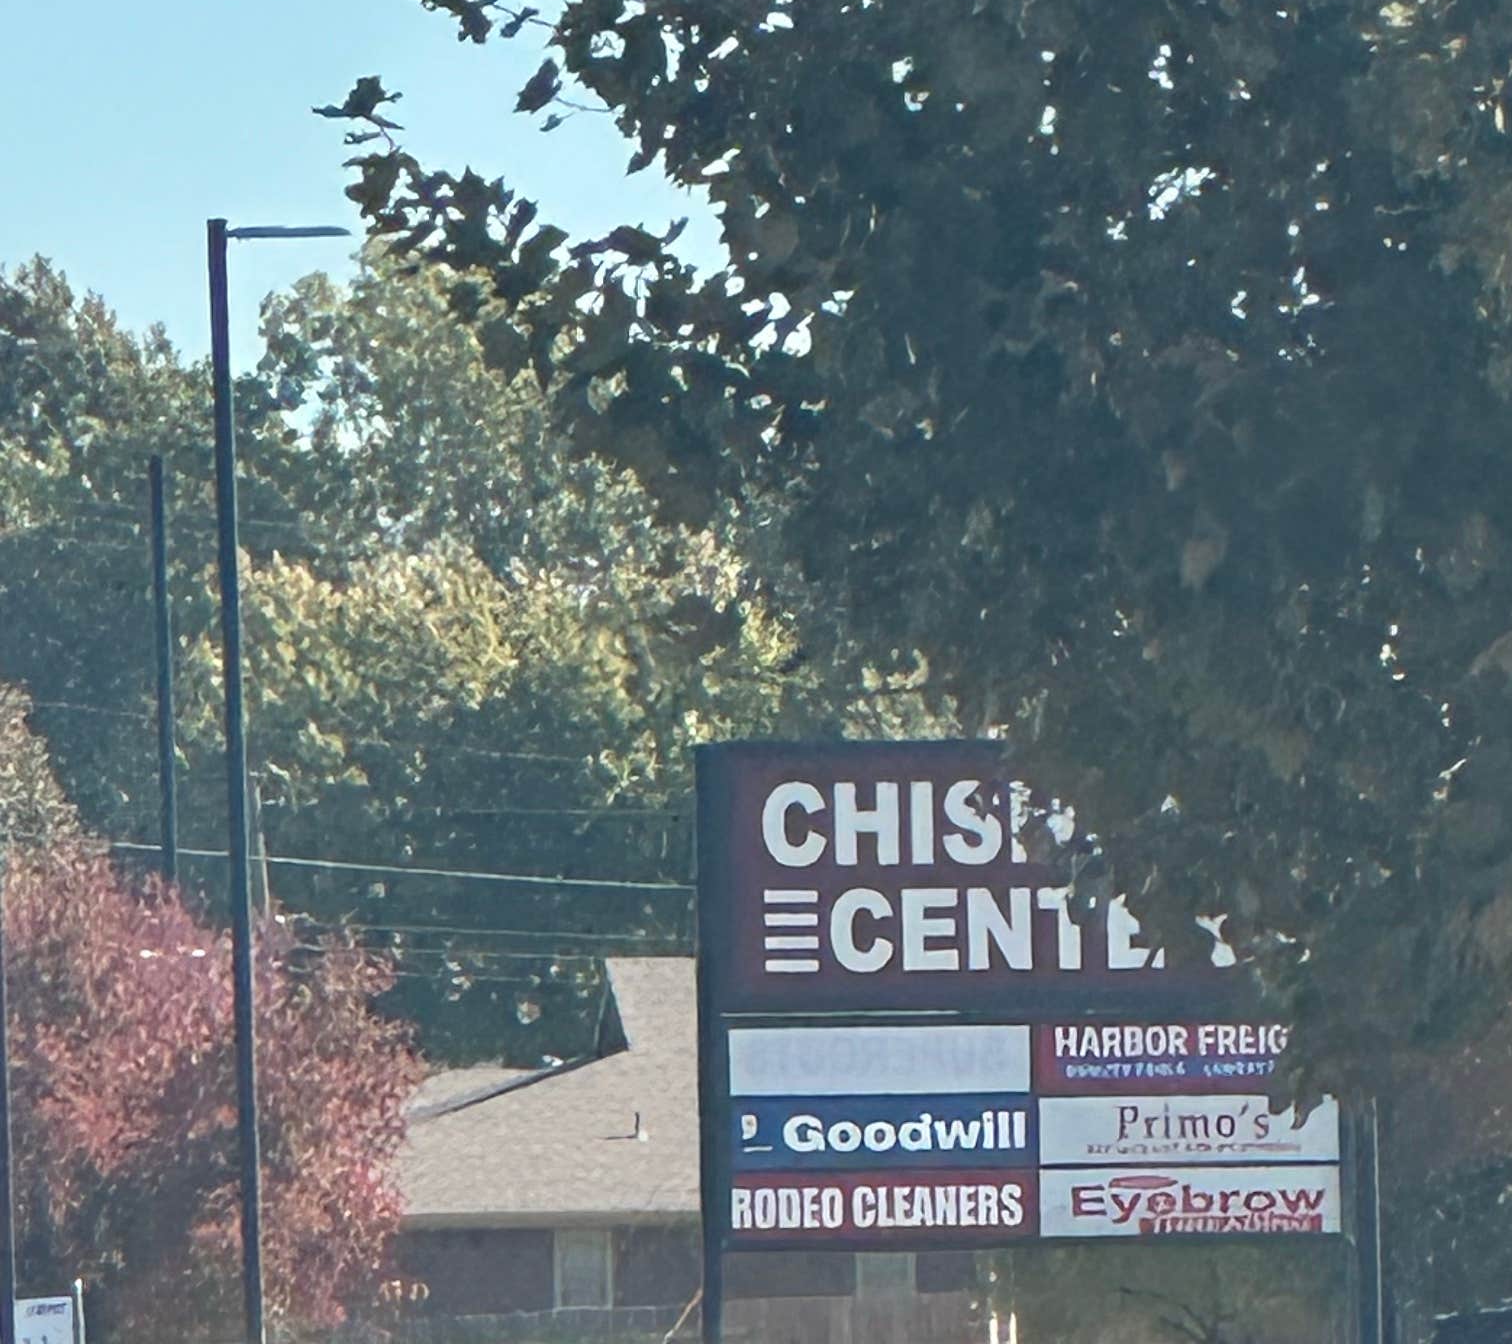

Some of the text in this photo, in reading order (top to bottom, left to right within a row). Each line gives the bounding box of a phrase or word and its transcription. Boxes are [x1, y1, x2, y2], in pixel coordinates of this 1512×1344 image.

[1055, 1025, 1190, 1058] HARBOR
[782, 1111, 1027, 1153] Goodwill
[1113, 1101, 1270, 1142] Primo's
[730, 1183, 1025, 1230] RODEO CLEANERS
[1070, 1183, 1326, 1224] Eyebrow
